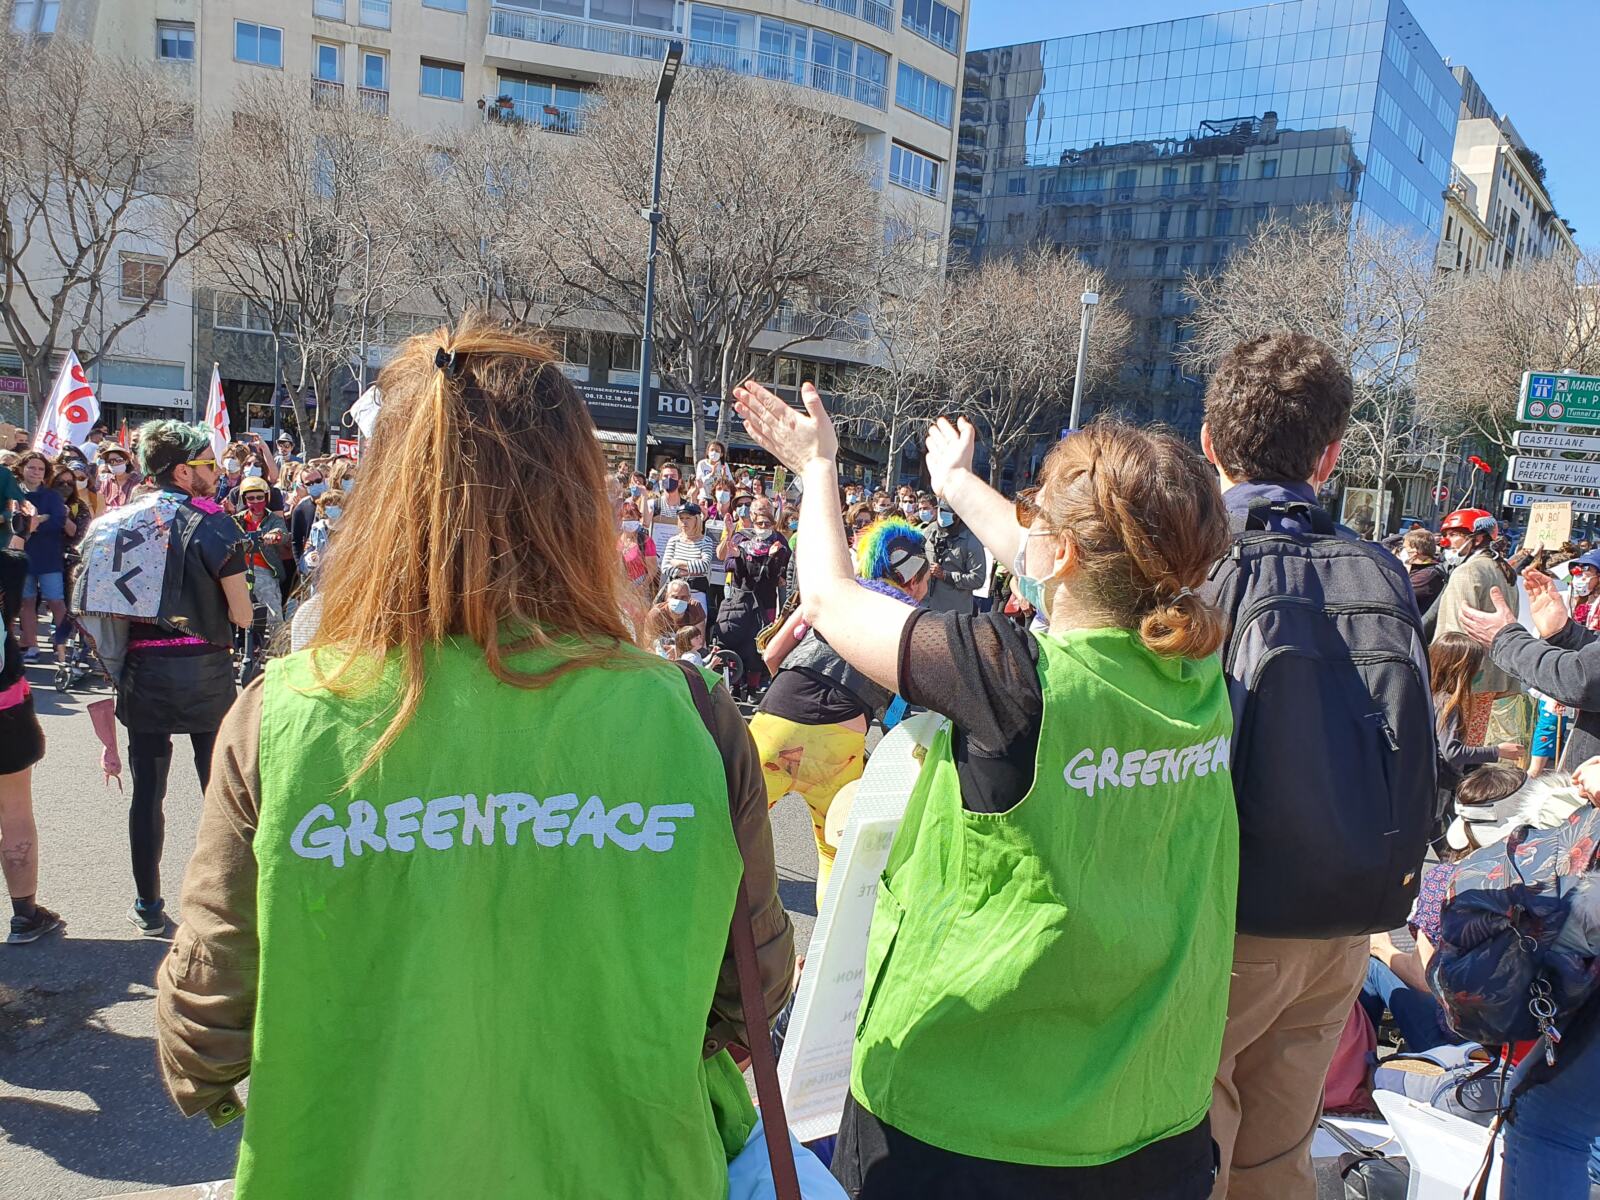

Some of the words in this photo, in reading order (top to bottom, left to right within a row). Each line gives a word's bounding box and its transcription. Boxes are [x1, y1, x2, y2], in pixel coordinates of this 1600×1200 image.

[173, 397, 190, 406] 314
[1554, 392, 1572, 403] AIX
[1592, 395, 1599, 405] P
[1524, 436, 1584, 448] CASTELLANE
[1520, 461, 1557, 471] CENTRE
[1565, 465, 1592, 474] VILLE
[1063, 734, 1231, 798] GREENPEA
[290, 793, 695, 868] GREENPEACE
